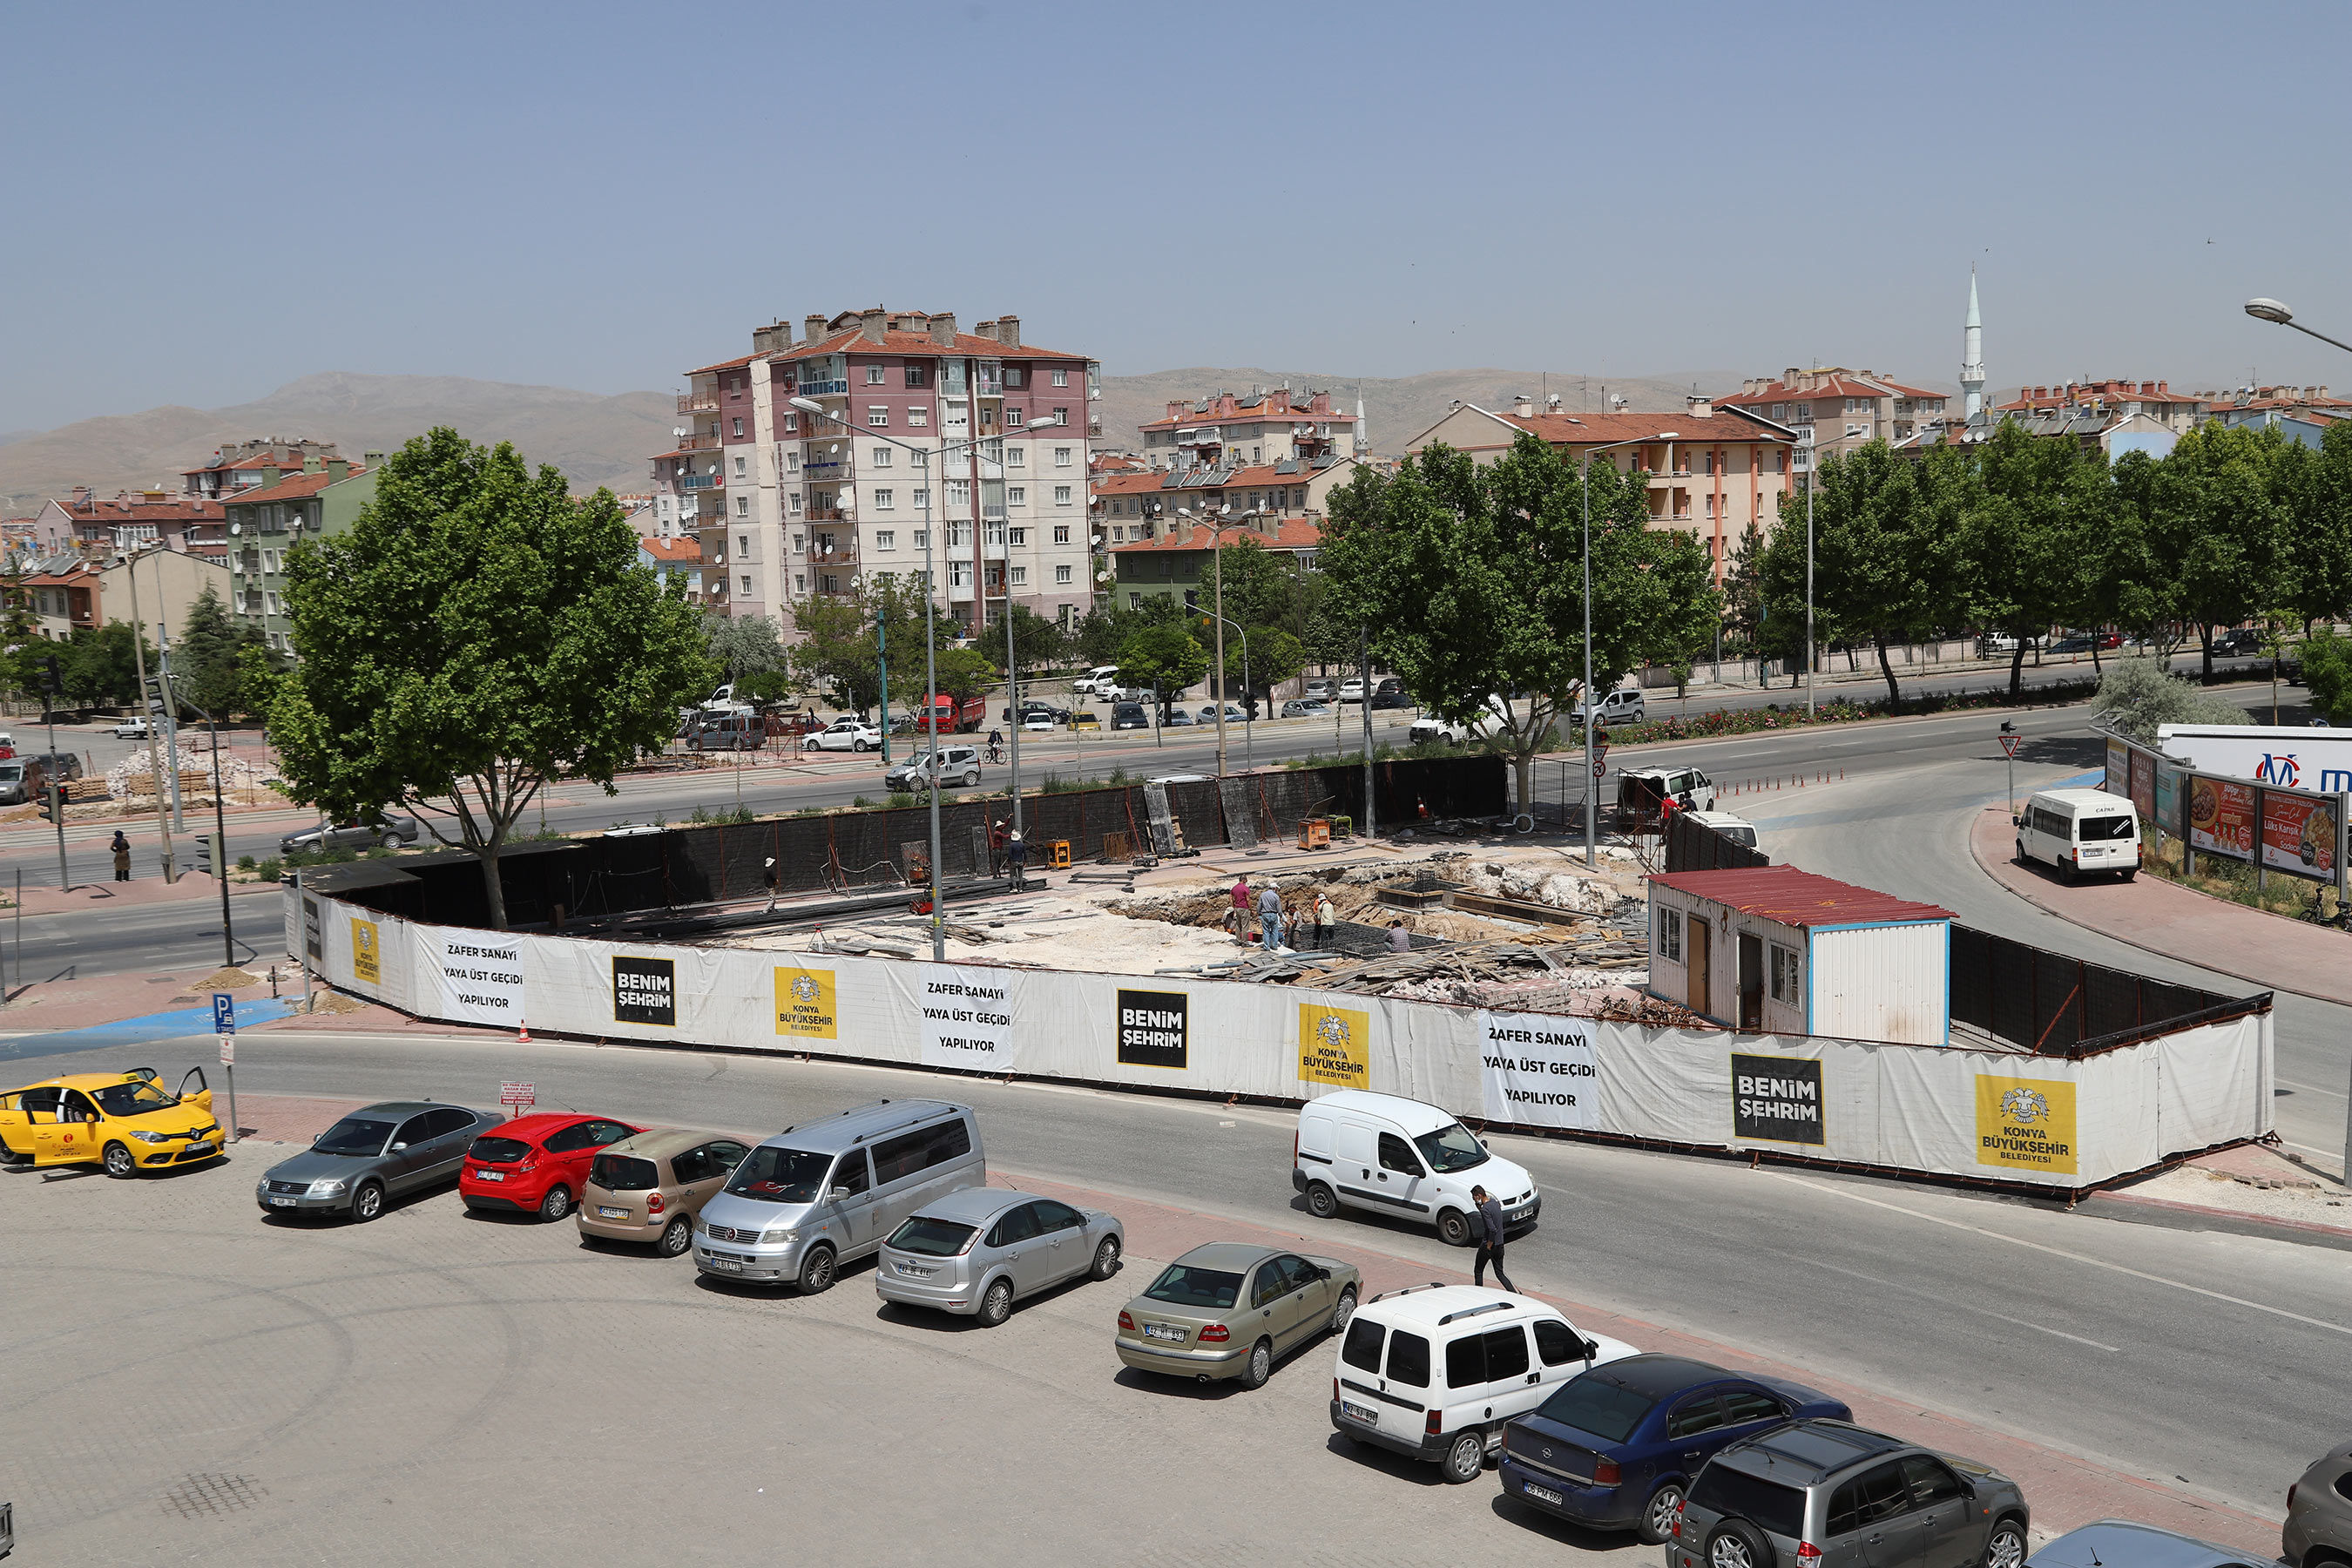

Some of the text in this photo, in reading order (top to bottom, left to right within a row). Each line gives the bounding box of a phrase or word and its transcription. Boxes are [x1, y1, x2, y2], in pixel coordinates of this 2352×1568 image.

[2264, 820, 2278, 832] Lüks
[448, 944, 479, 957] ZAFER
[443, 967, 468, 979] YAYA
[470, 968, 488, 982] ÜST
[928, 983, 963, 996] ZAFER
[217, 997, 229, 1018] P
[458, 993, 509, 1008] YAPILIYOR
[793, 1004, 820, 1014] KONYA
[923, 1007, 950, 1021] YAYA
[952, 1008, 972, 1023] ÜST
[780, 1012, 833, 1027] BÜYÜKŞEHİR
[790, 1024, 822, 1032] BELEDİYESİ
[1488, 1027, 1532, 1044] ZAFER
[939, 1036, 995, 1052] YAPILIYOR
[1317, 1047, 1348, 1060] KONYA
[1302, 1056, 1363, 1074] BÜYÜKŞEHİR
[1483, 1056, 1516, 1071] YAYA
[1519, 1056, 1546, 1073] ÜST
[1315, 1069, 1351, 1080] BELEDİYESİ
[1504, 1088, 1577, 1107] YAPILIYOR
[2004, 1126, 2047, 1139] KONYA
[1982, 1134, 2069, 1156] BÜYÜKŞEHİR
[2000, 1152, 2051, 1164] BELEDİYESİ
[1172, 1330, 1183, 1339] 893
[1347, 1404, 1376, 1422] 42 SJ 894
[1527, 1484, 1562, 1504] 06 PM 666
